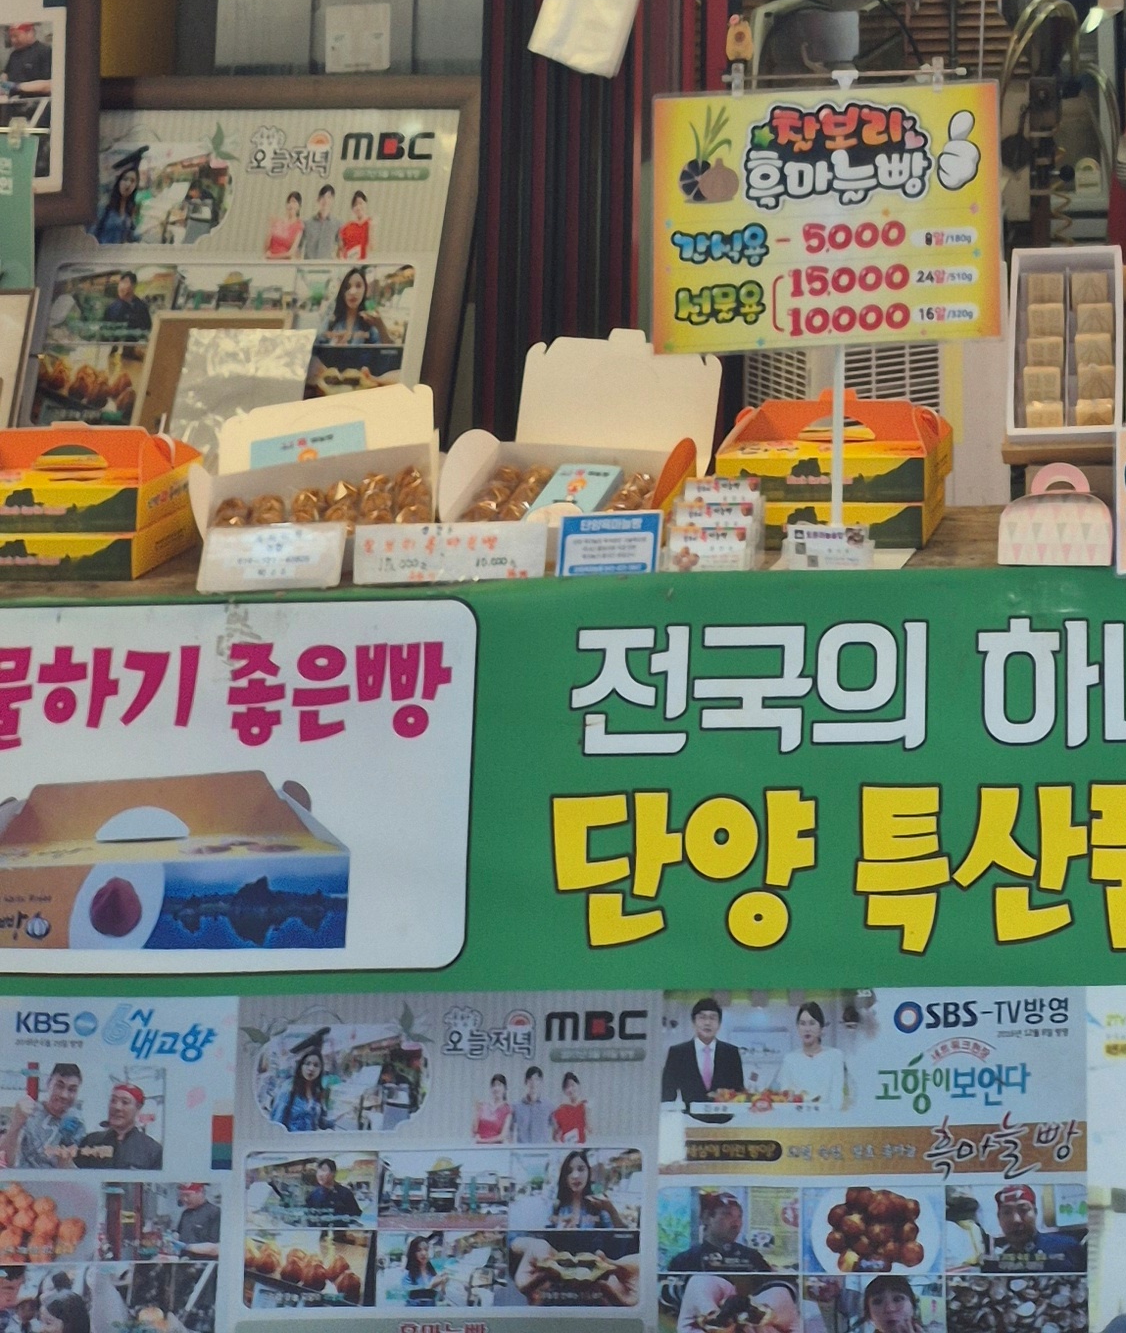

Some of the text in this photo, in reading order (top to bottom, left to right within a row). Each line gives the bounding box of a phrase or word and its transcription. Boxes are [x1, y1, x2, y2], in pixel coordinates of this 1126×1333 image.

[770, 105, 904, 153] 찰보리
[250, 147, 330, 175] 오늘저녁
[746, 149, 932, 209] 흑마늘빵
[671, 223, 769, 266] 간식용
[674, 280, 766, 325] 선물용
[226, 640, 453, 748] 좋은빵
[569, 618, 930, 757] 전국의
[550, 786, 820, 952] 단양
[15, 1010, 71, 1035] KBS
[129, 1023, 219, 1064] 내고향
[444, 1031, 532, 1059] 오늘저녁
[544, 1009, 649, 1042] MBC
[924, 1111, 1083, 1181] 흑마늘빵
